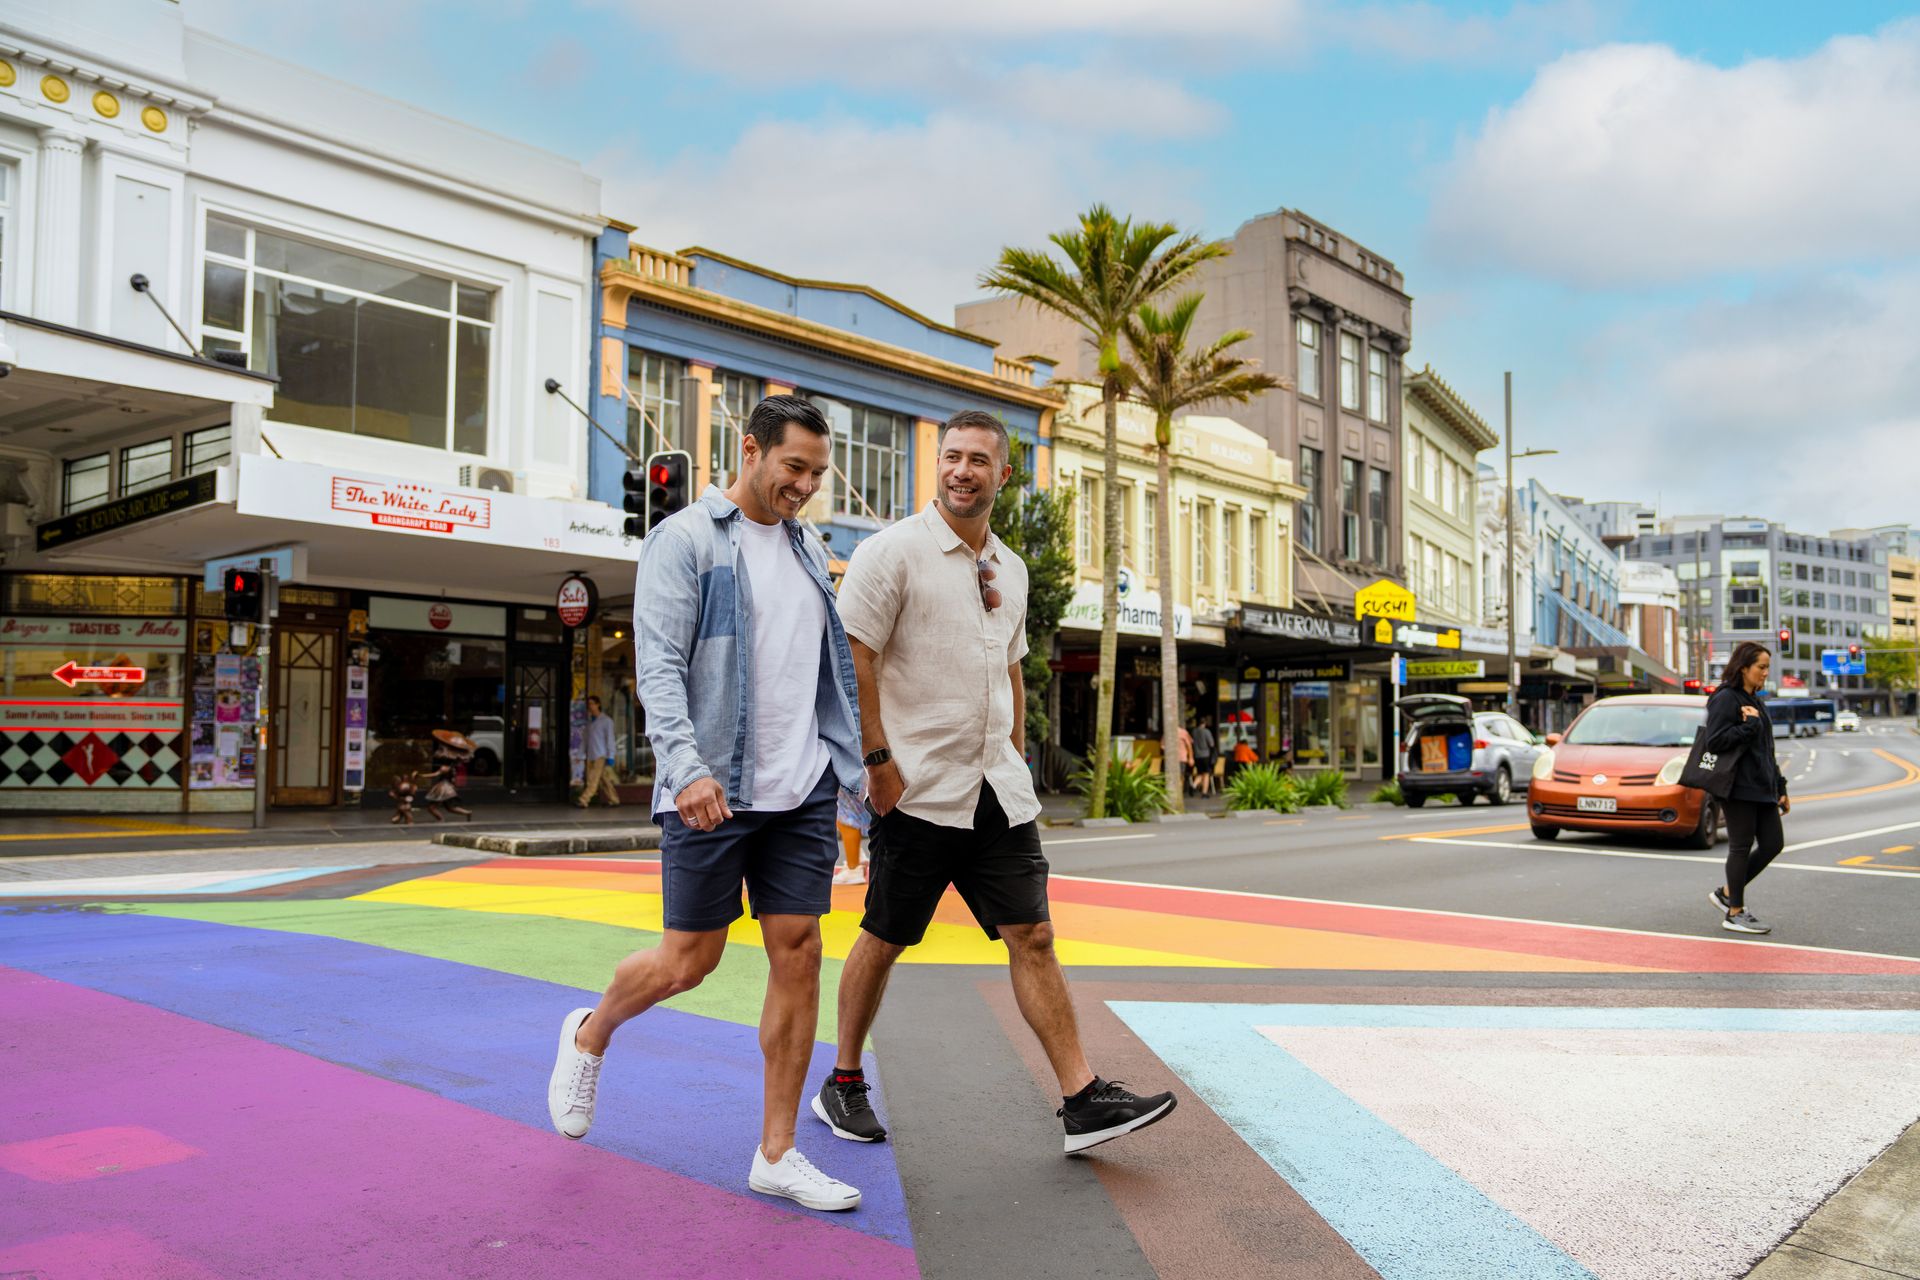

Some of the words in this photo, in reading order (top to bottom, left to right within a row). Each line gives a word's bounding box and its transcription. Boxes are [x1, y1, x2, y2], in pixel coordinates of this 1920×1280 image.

[346, 486, 379, 505] The
[382, 491, 430, 512] White
[433, 500, 477, 522] Lady
[429, 521, 448, 532] ROAD
[569, 520, 615, 538] Authentic
[544, 537, 560, 548] 183
[562, 587, 586, 604] Sal's
[1363, 600, 1407, 613] SUSHI
[2, 619, 49, 638] Burgers
[69, 622, 120, 635] TOASTIES
[136, 620, 180, 637] Shakes
[1276, 611, 1331, 638] VERONA
[1277, 666, 1315, 681] pierres
[1316, 664, 1344, 678] sushi
[5, 710, 28, 721] Same
[64, 711, 87, 721] Same
[131, 711, 154, 721] Since
[1579, 799, 1615, 810] LNN712
